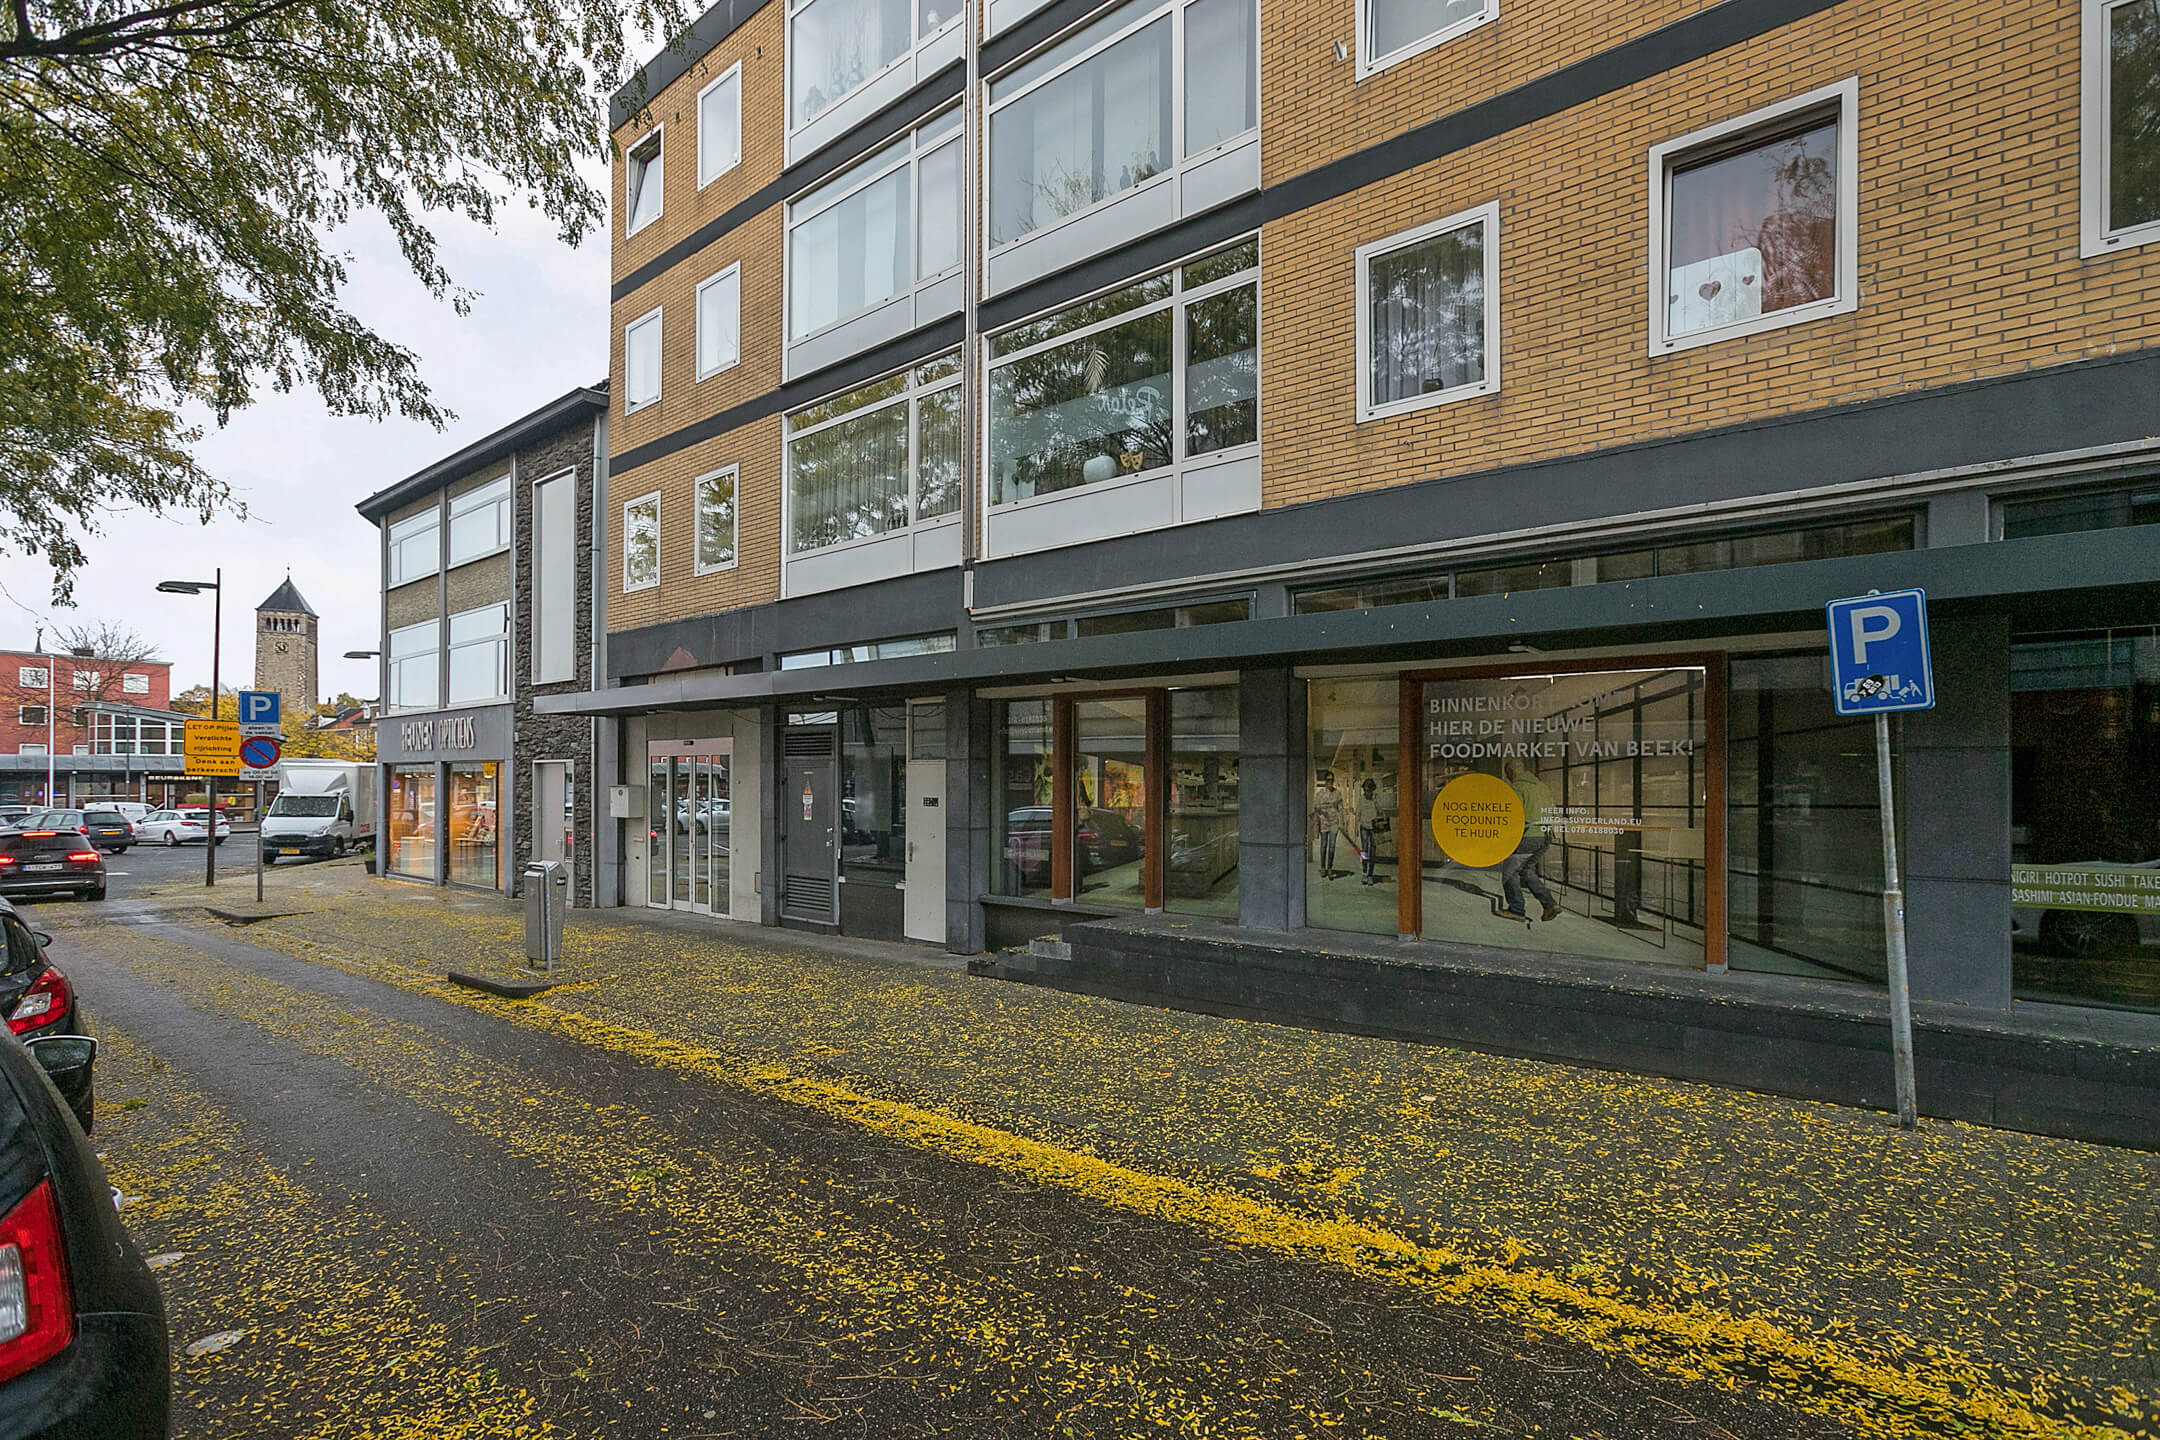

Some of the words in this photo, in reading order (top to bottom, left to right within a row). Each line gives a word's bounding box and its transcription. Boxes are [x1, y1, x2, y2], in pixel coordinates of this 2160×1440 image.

[1850, 606, 1901, 664] P
[249, 695, 272, 721] P
[1430, 720, 1473, 736] HIER
[1480, 719, 1505, 735] DE
[1511, 715, 1595, 734] NIEUWE
[1430, 741, 1570, 758] FOODMARKET
[1575, 740, 1618, 757] VAN
[1626, 738, 1695, 757] BEEK!
[1442, 802, 1468, 811] NOG
[1470, 802, 1512, 812] ENKELE
[1446, 815, 1509, 826] FOODUNITS
[1455, 828, 1468, 837] TE
[1470, 828, 1499, 839] HUUR
[2045, 871, 2088, 886] HOTPOT
[2095, 873, 2126, 888] SUSHI
[2012, 888, 2053, 902] SASHIMI
